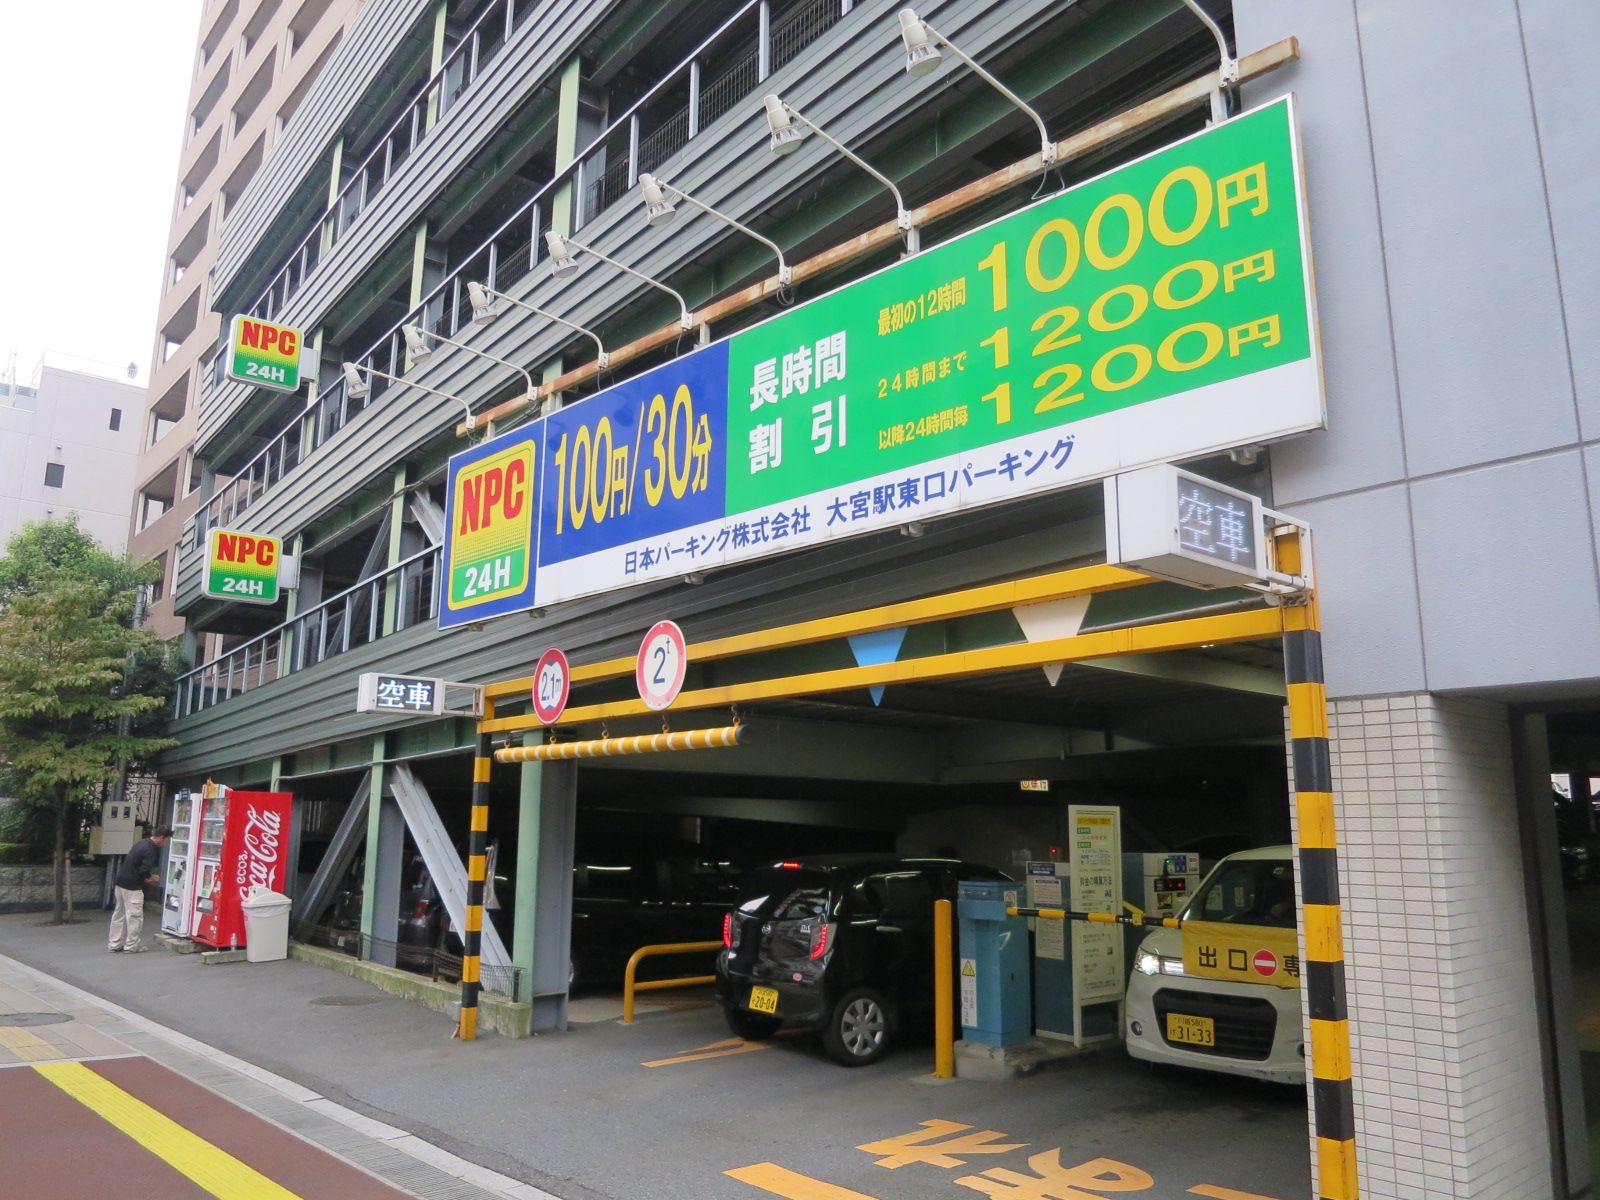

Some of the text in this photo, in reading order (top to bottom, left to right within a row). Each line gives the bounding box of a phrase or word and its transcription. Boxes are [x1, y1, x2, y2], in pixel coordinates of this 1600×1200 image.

[877, 161, 1269, 336] 最初の12時間 1000円
[241, 321, 296, 356] NPC
[878, 248, 1276, 398] 24時間まで 1200円
[245, 362, 285, 383] 24H
[749, 330, 847, 412] 長時間
[879, 313, 1281, 450] 以降24時間毎 1200円
[555, 384, 712, 535] 100円/30分
[748, 394, 847, 475] 割引
[459, 458, 525, 536] NPC
[625, 434, 1076, 575] 日本パーキング株式会社 大宮駅東口パーキング
[1179, 489, 1250, 562] 空車
[217, 533, 274, 566] NPC
[463, 556, 511, 598] 24H
[222, 577, 264, 595] 24H
[377, 680, 432, 709] 空車
[541, 671, 562, 702] 2.1m
[240, 803, 281, 901] ca-Cola
[1198, 945, 1248, 972] 出口
[755, 996, 775, 1011] 20-04
[1177, 1025, 1212, 1044] 31-33
